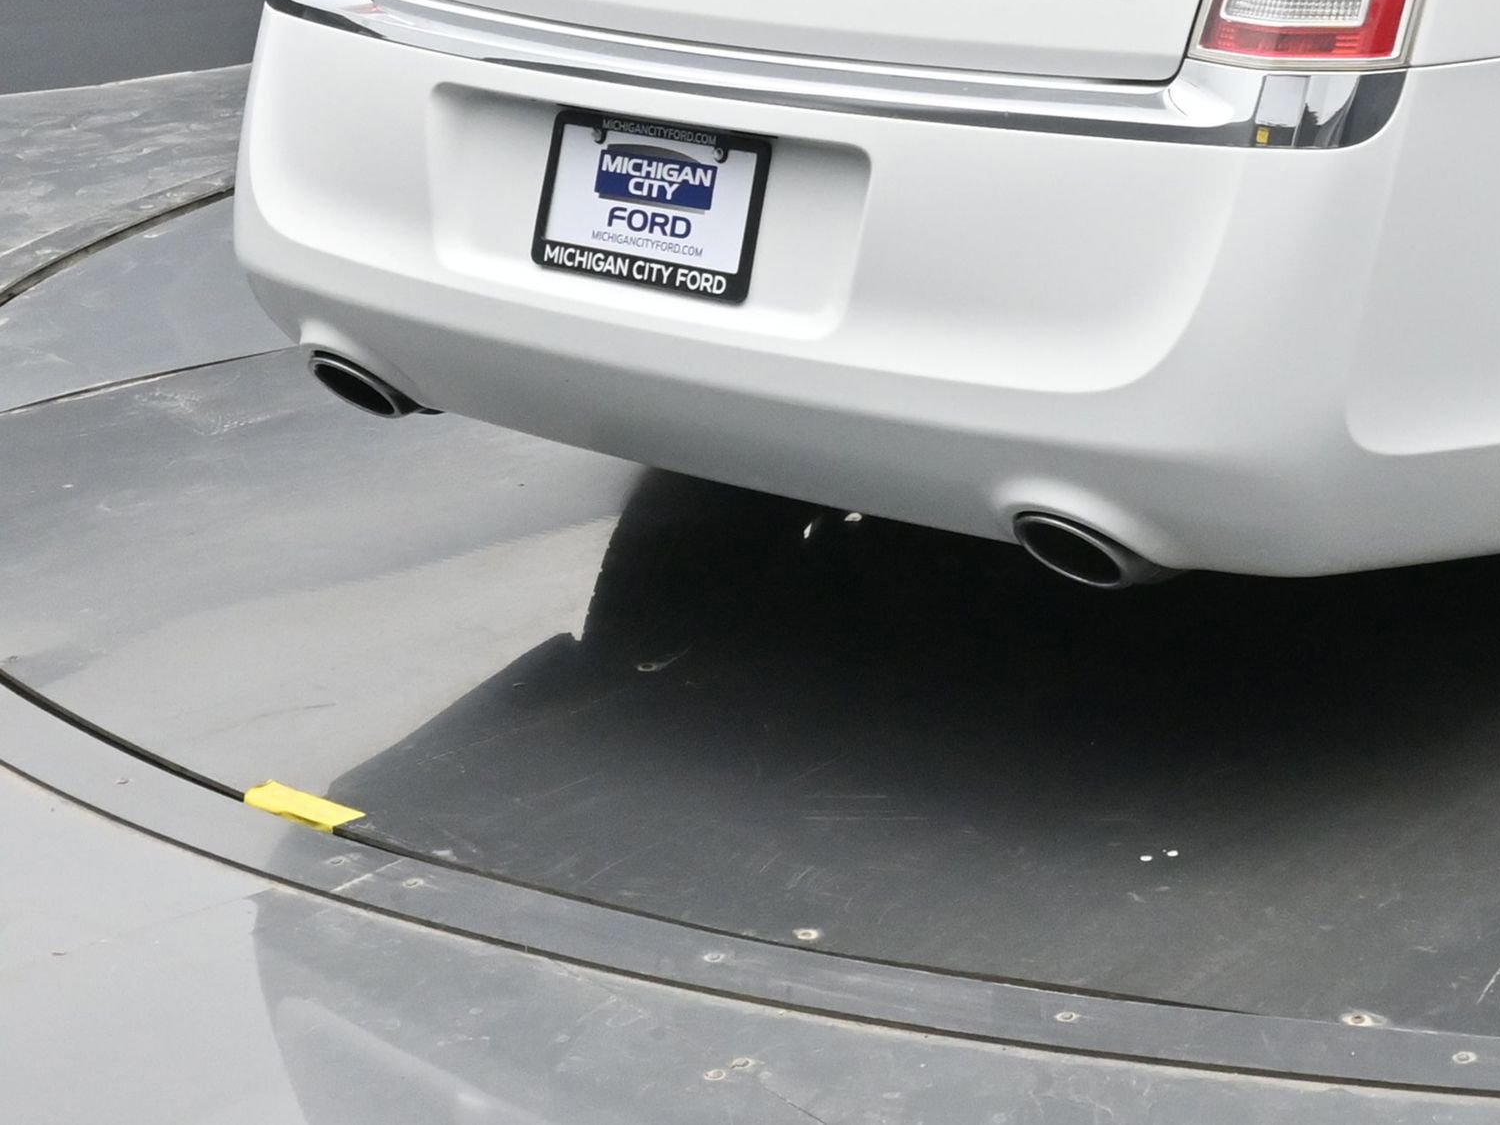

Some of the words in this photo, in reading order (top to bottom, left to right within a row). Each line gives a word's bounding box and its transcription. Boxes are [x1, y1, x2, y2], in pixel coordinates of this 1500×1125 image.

[602, 118, 717, 145] MICHIGANCITYFORD.COM
[601, 154, 713, 187] MICHIGAN
[628, 177, 680, 200] CITY
[607, 206, 692, 239] FORD
[591, 230, 703, 257] MICHIGANCITYFORD.COM
[543, 244, 629, 276] MICHIGAN
[632, 260, 673, 284] CITY
[675, 268, 727, 295] FORD
